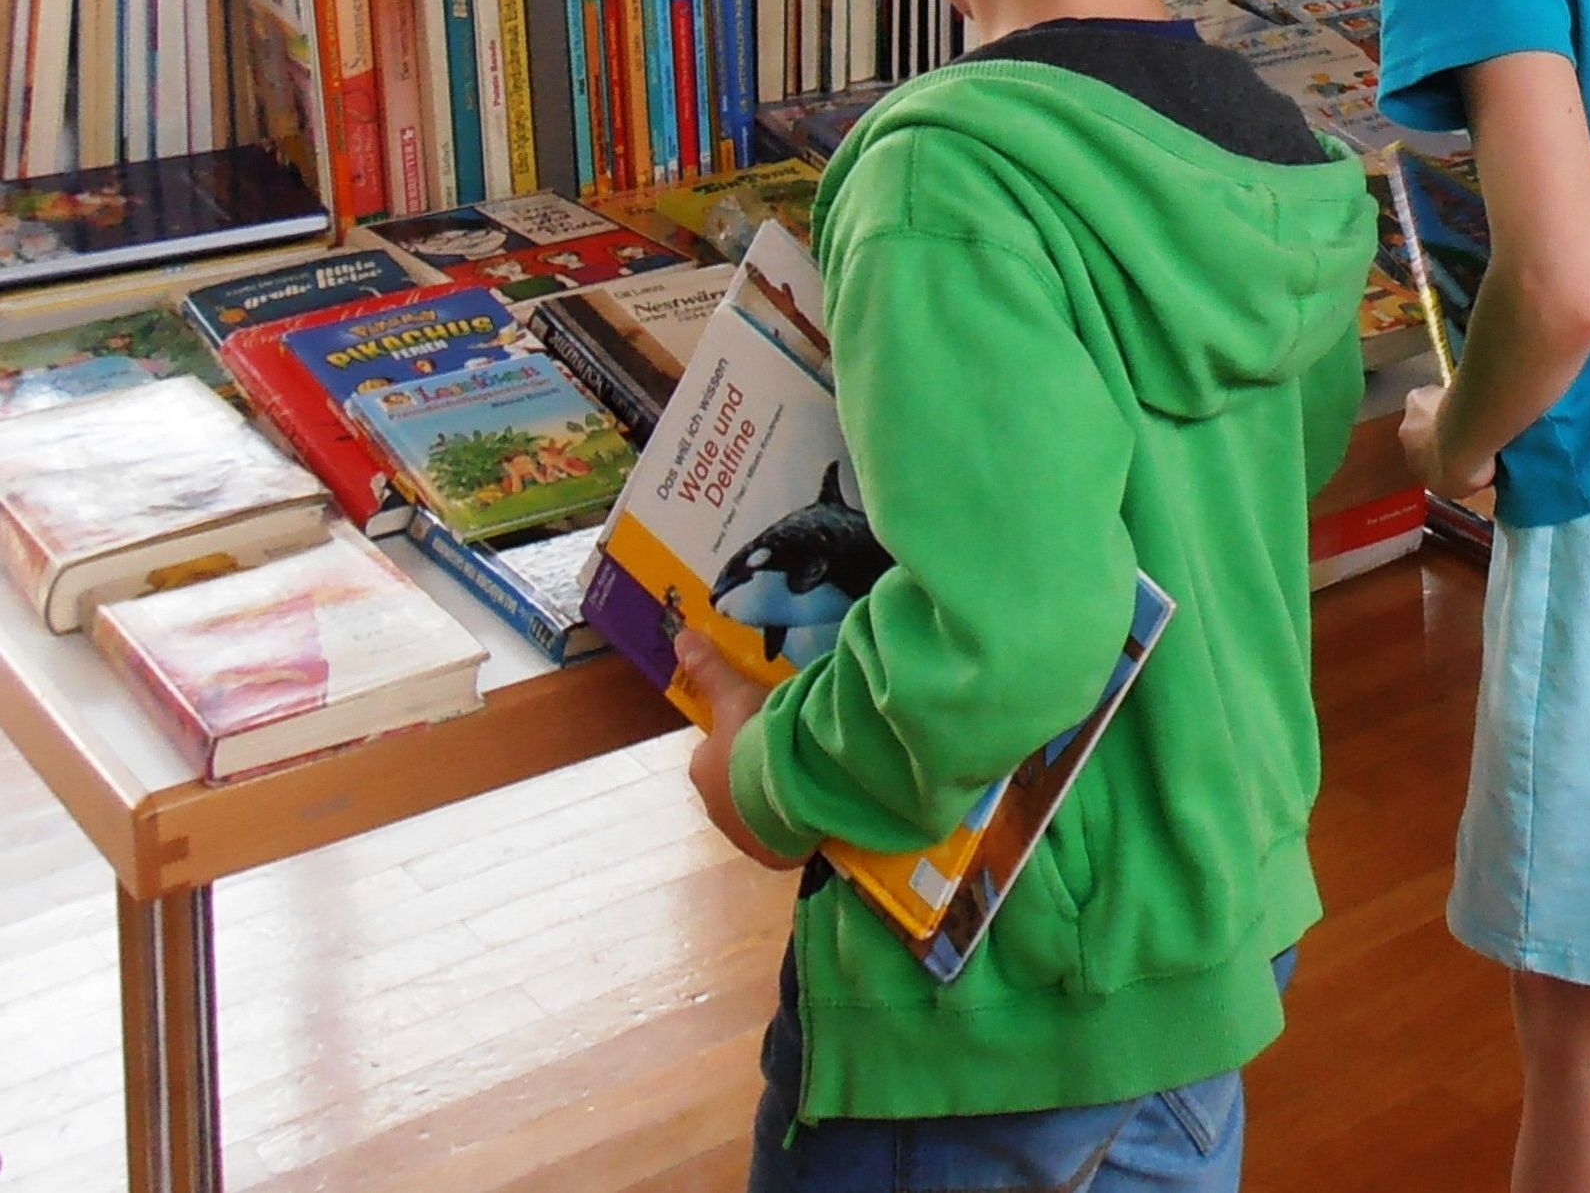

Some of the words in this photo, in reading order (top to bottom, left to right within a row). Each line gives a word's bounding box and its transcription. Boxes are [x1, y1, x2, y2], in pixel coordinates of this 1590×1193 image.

[325, 315, 494, 369] PIKACHUS
[656, 469, 678, 501] Das
[674, 437, 692, 466] will
[686, 413, 703, 438] ich
[700, 357, 729, 411] wissen
[678, 440, 719, 503] Wale
[714, 383, 743, 436] und
[704, 419, 755, 508] Delfine
